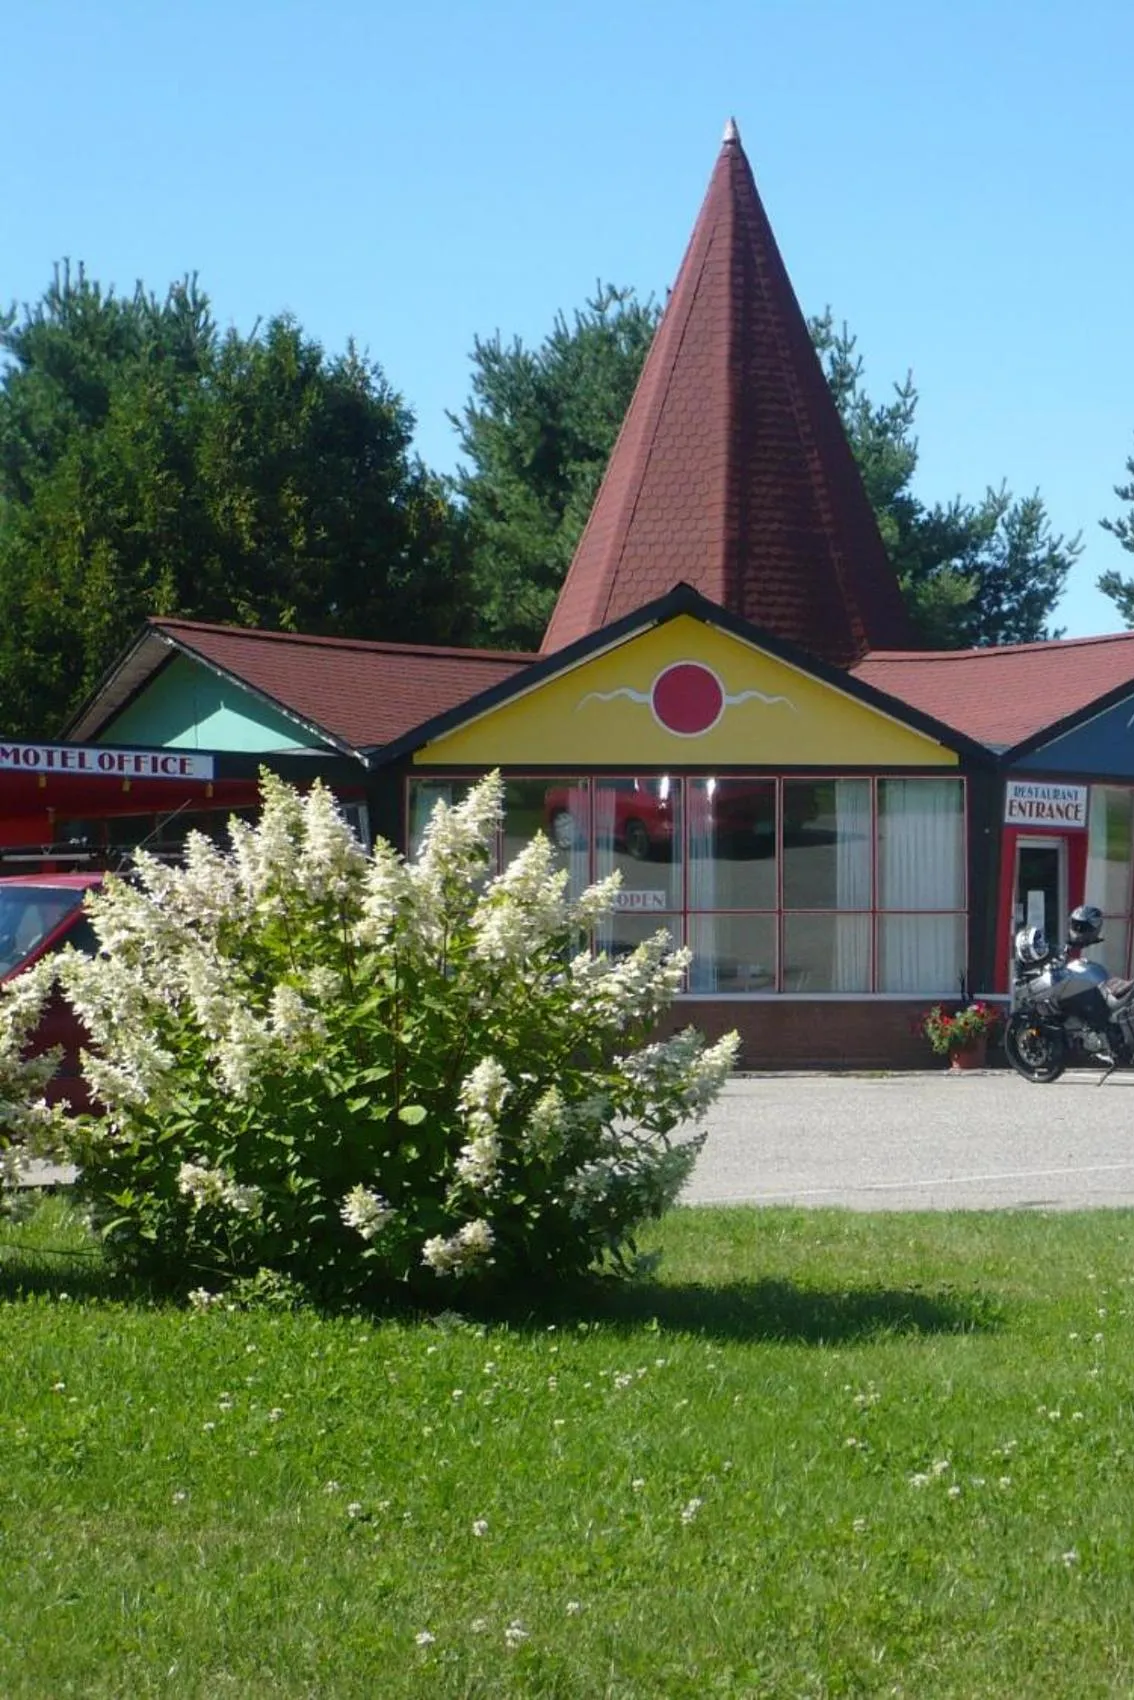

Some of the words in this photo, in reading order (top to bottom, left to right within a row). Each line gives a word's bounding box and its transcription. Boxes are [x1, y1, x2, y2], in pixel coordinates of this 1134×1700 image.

[0, 746, 93, 770] MOTEL
[97, 751, 194, 776] OFFICE
[1013, 785, 1079, 800] RESTAURANT
[1008, 799, 1083, 821] ENTRANCE
[616, 892, 664, 908] OPEN
